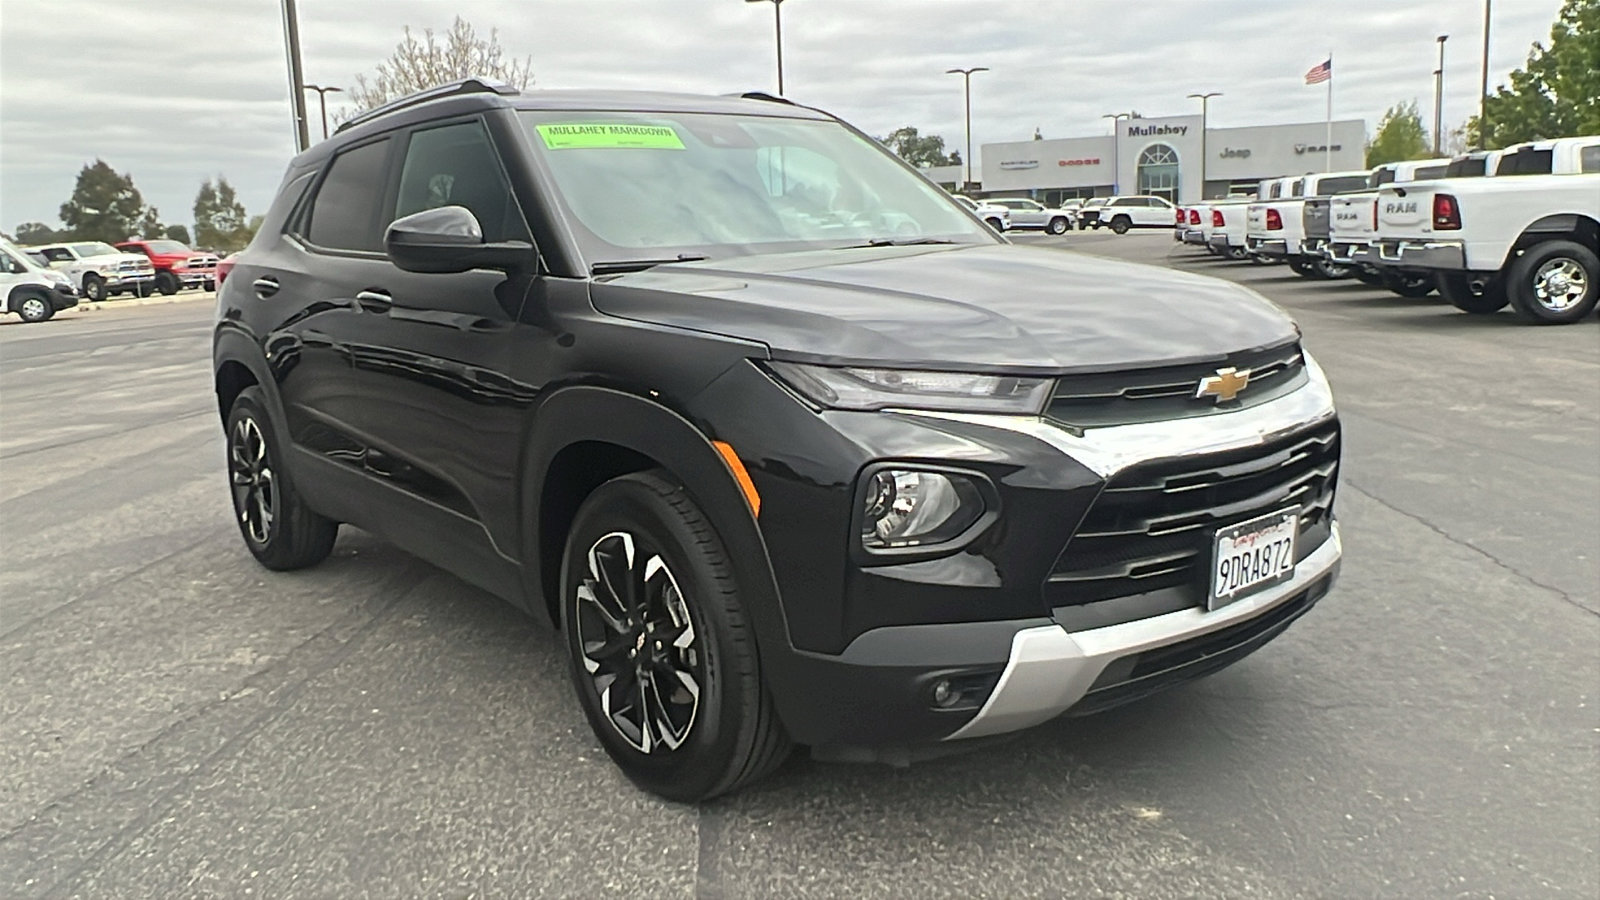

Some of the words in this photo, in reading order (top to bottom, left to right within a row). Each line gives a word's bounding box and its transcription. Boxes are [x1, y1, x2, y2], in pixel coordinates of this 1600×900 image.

[548, 126, 606, 136] MULLAHEY
[609, 126, 672, 137] MARKDOWN
[1128, 125, 1188, 137] Mullahey
[1219, 147, 1251, 159] Jeep
[1386, 202, 1417, 214] RAM
[1219, 537, 1291, 594] 9DRA872
